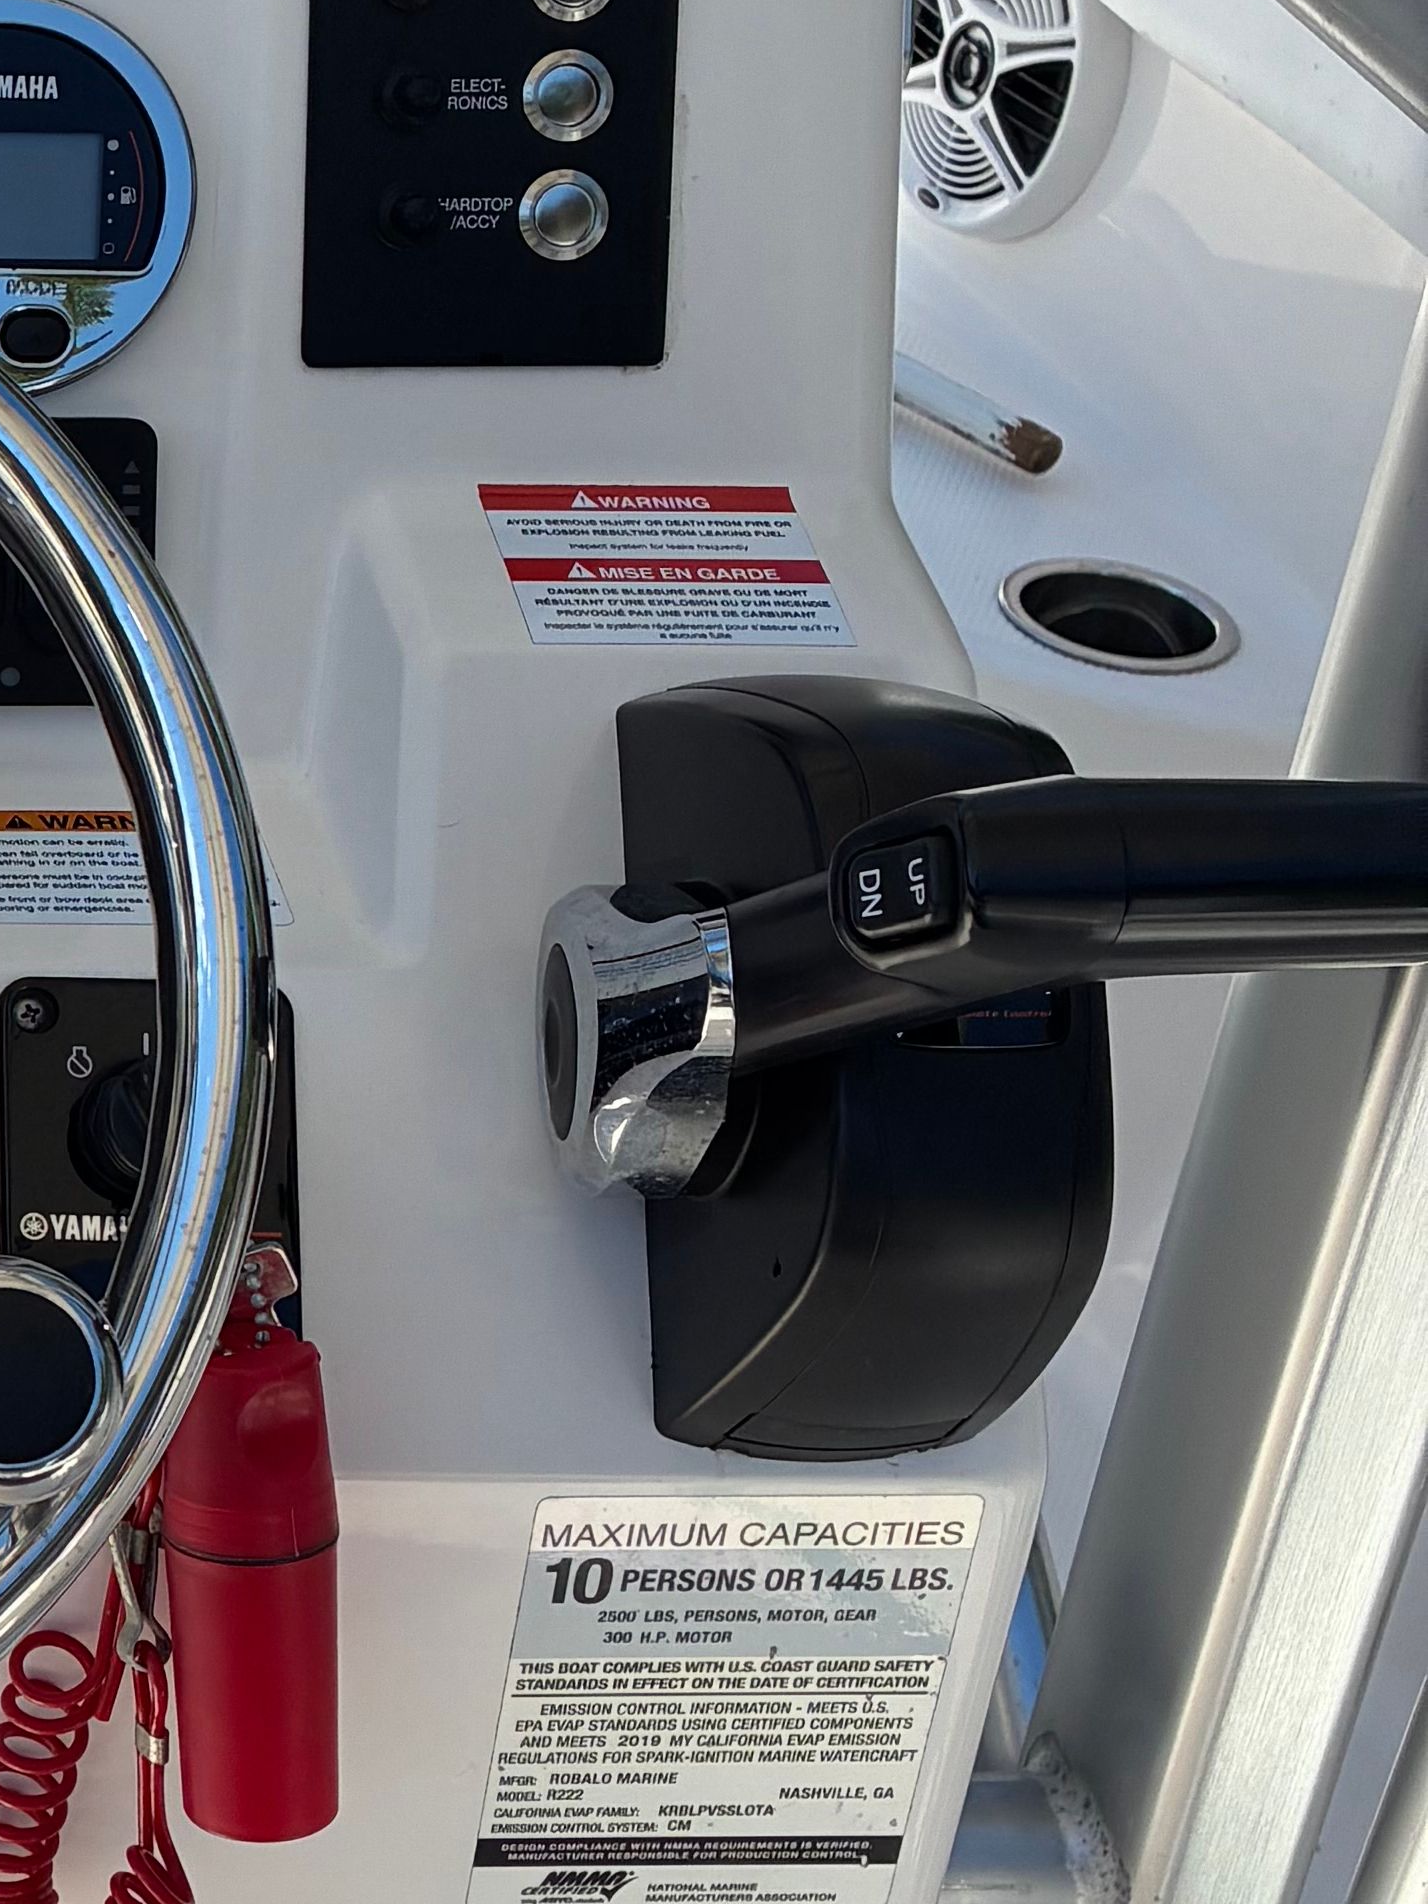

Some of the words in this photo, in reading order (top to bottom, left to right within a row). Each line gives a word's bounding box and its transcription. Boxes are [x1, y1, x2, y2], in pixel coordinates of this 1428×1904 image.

[450, 79, 506, 93] ELECT-
[447, 95, 508, 111] RONICS
[449, 214, 500, 230] /ACCY
[598, 496, 711, 510] WARNING
[598, 567, 655, 579] MISE
[661, 568, 692, 580] EN
[697, 568, 781, 580] GARDE
[906, 857, 926, 906] UP
[858, 867, 883, 918] DN
[541, 1523, 728, 1547] MAXIMUM
[739, 1521, 966, 1547] CAPACITIES
[546, 1557, 614, 1604] 10
[620, 1568, 756, 1592] PERSONS
[764, 1568, 805, 1592] OR
[810, 1568, 885, 1591] 1445
[890, 1567, 954, 1591] LBS.
[597, 1610, 637, 1623] 2500
[643, 1610, 679, 1624] LBS,
[684, 1609, 762, 1624] PERSONS,
[766, 1609, 828, 1623] MOTOR,
[834, 1609, 877, 1621] GEAR
[603, 1631, 633, 1644] 300
[640, 1631, 669, 1643] H.P.
[675, 1631, 733, 1643] MOTOR
[519, 1660, 555, 1675] THIS
[558, 1662, 600, 1675] BOAT
[603, 1661, 681, 1674] COMPLIES
[685, 1661, 725, 1673] WITH
[728, 1661, 757, 1673] U.S.
[760, 1660, 814, 1672] COAST
[816, 1660, 870, 1672] GUARD
[874, 1659, 935, 1671] SAFETY
[499, 1776, 538, 1786] MFGR:
[549, 1772, 612, 1785] ROBALO
[616, 1772, 679, 1784] MARINE
[496, 1791, 542, 1802] MODEL:
[546, 1789, 584, 1801] R222
[778, 1787, 868, 1801] NASHVILLE,
[873, 1787, 894, 1799] GA
[493, 1807, 561, 1819] CALIFORNIA
[563, 1807, 594, 1817] EVAP
[596, 1807, 640, 1817] FAMILY:
[647, 1883, 708, 1892] NATIONAL
[710, 1883, 759, 1892] MARINE
[645, 1894, 754, 1903] MANUFACTURERS
[755, 1893, 837, 1902] ASSOCIATION
